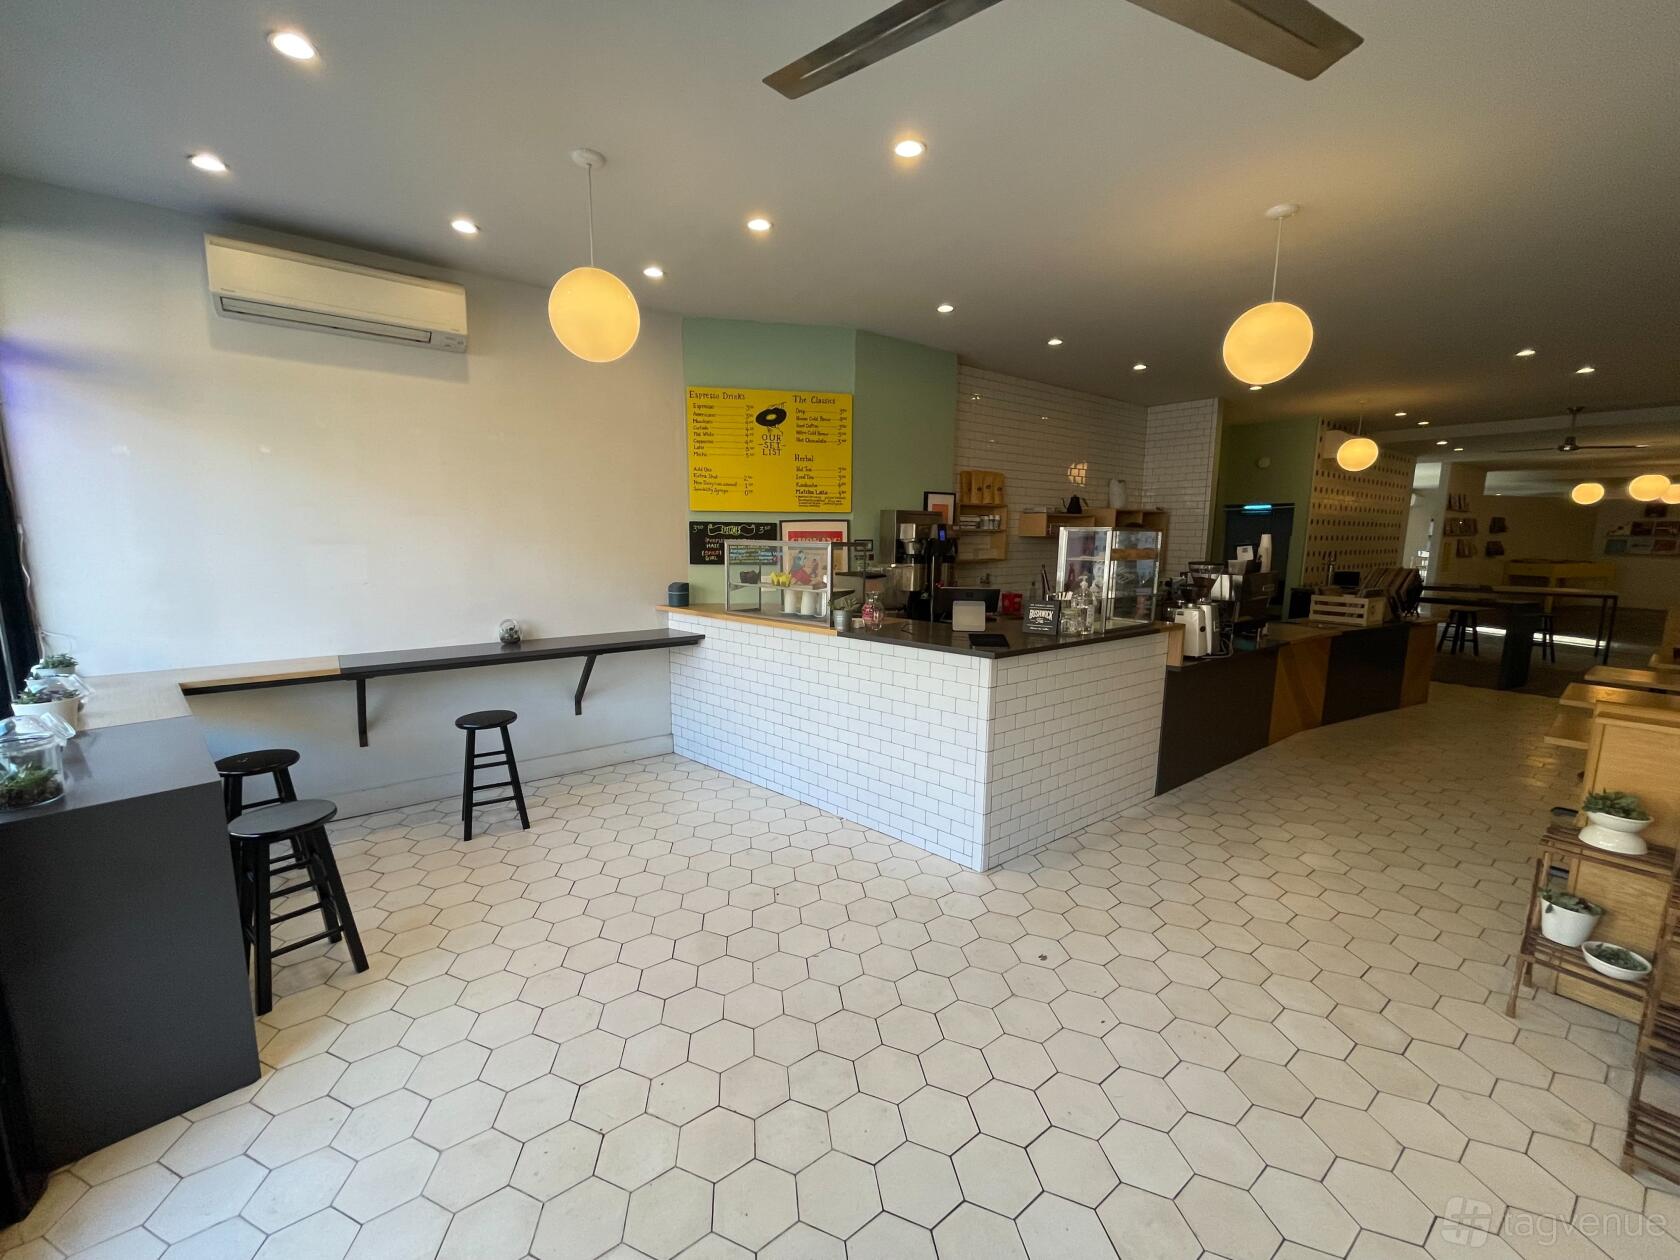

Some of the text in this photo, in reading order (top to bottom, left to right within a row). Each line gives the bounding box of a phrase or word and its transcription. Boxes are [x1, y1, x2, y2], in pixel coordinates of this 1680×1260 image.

[722, 392, 746, 400] Drinks
[792, 395, 807, 404] The
[762, 434, 782, 442] OUR
[762, 449, 782, 457] LIST
[795, 453, 814, 462] Herbal
